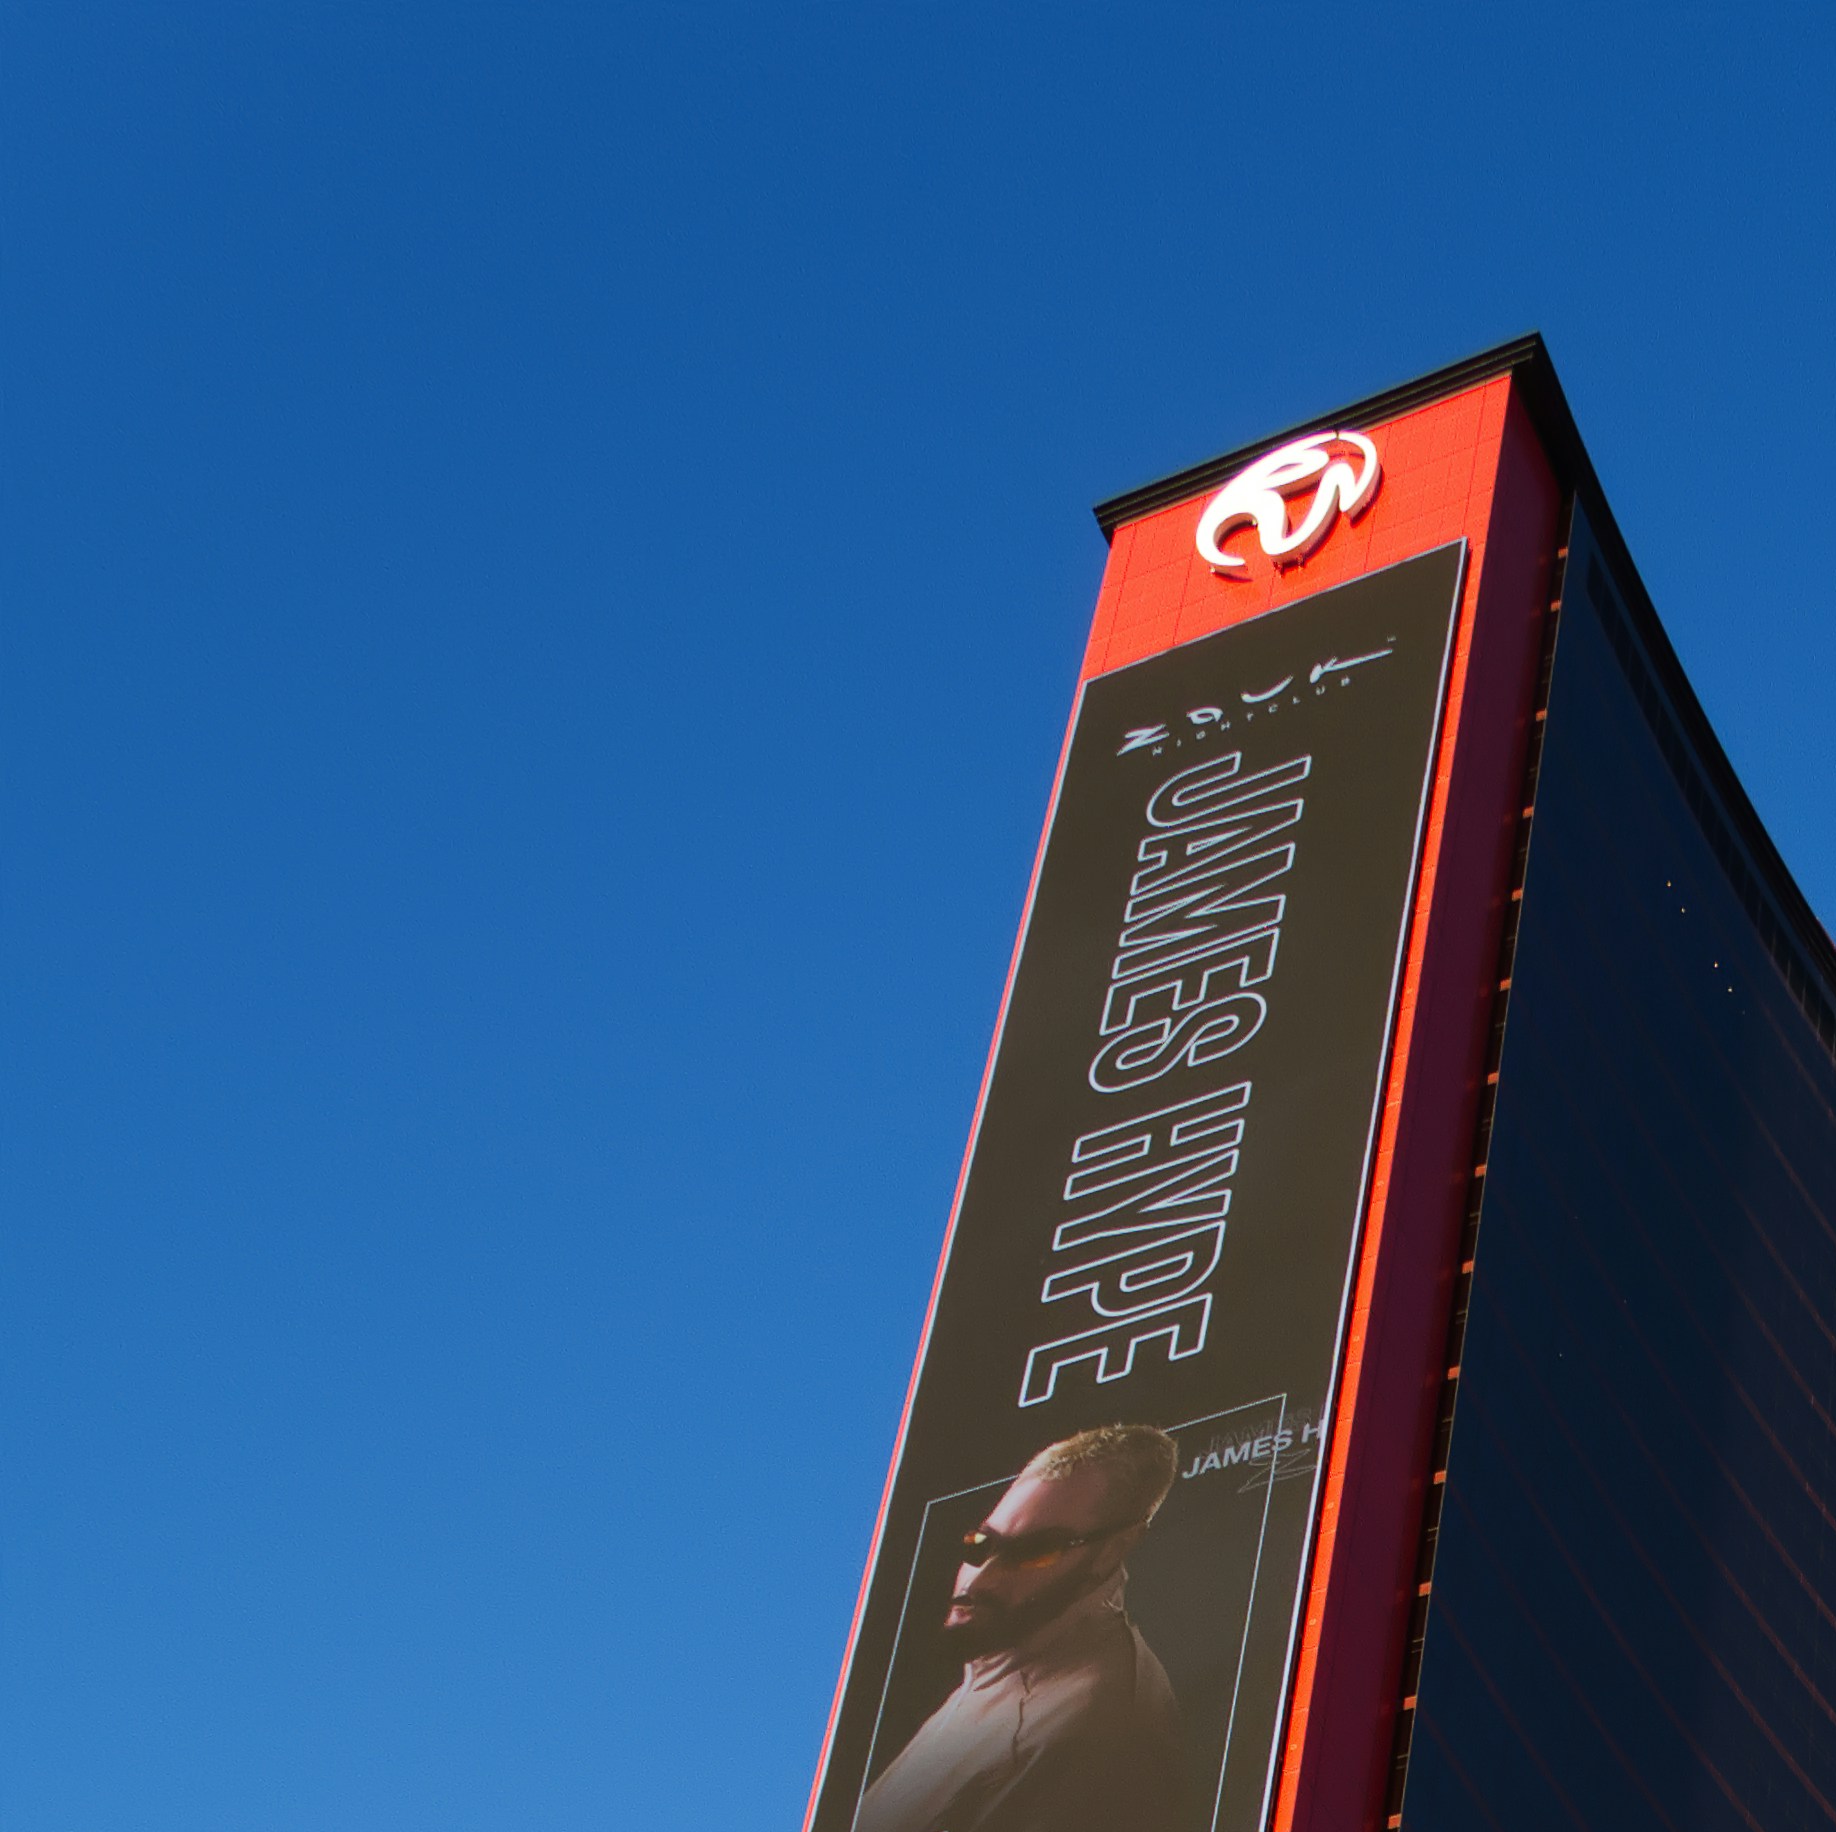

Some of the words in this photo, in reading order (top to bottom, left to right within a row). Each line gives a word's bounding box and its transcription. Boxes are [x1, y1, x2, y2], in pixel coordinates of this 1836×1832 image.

[1088, 751, 1312, 1094] JAMES
[1018, 1081, 1252, 1408] HYPE
[1181, 1429, 1294, 1480] JAMES
